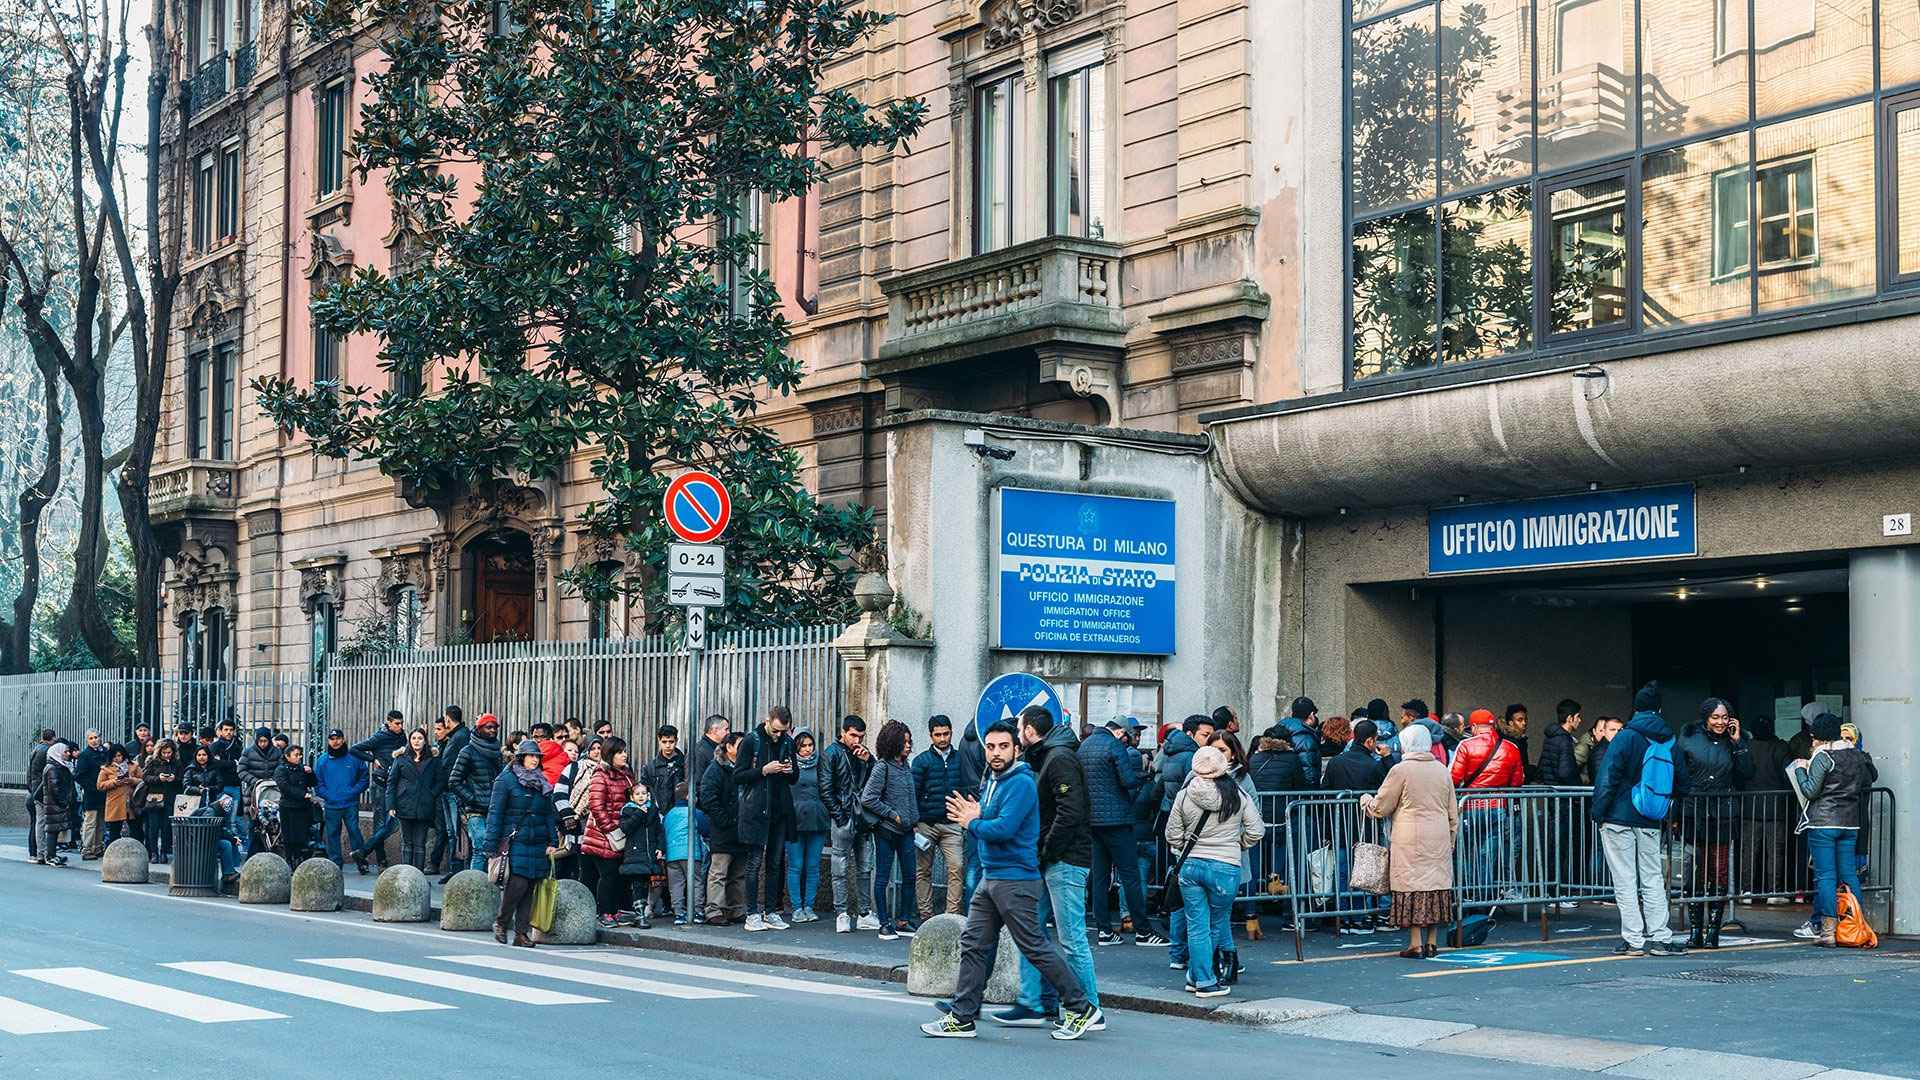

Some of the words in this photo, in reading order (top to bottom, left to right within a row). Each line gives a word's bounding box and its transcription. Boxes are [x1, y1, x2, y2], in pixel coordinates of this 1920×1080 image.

[1442, 518, 1516, 556] UFFICIO
[1522, 503, 1680, 550] IMMIGRAZIONE
[1890, 518, 1904, 531] 28
[1007, 532, 1085, 551] QUESTURA
[1093, 538, 1107, 552] DI
[1114, 540, 1168, 556] MILANO
[679, 552, 715, 566] 0-24
[1019, 563, 1090, 585] POLIZIA
[1092, 576, 1101, 585] DI
[1102, 567, 1157, 588] STATO
[1029, 591, 1069, 602] UFFICIO
[1074, 594, 1145, 606] IMMIGRAZIONE
[1043, 606, 1100, 617] IMMIGRATION
[1103, 609, 1131, 618] OFFICE
[1039, 619, 1069, 628] OFFICE
[1073, 620, 1135, 631] D'IMMIGRATION
[1034, 632, 1068, 641] OFICINA
[1069, 633, 1081, 641] DE
[1083, 634, 1141, 644] EXTRANJEROS
